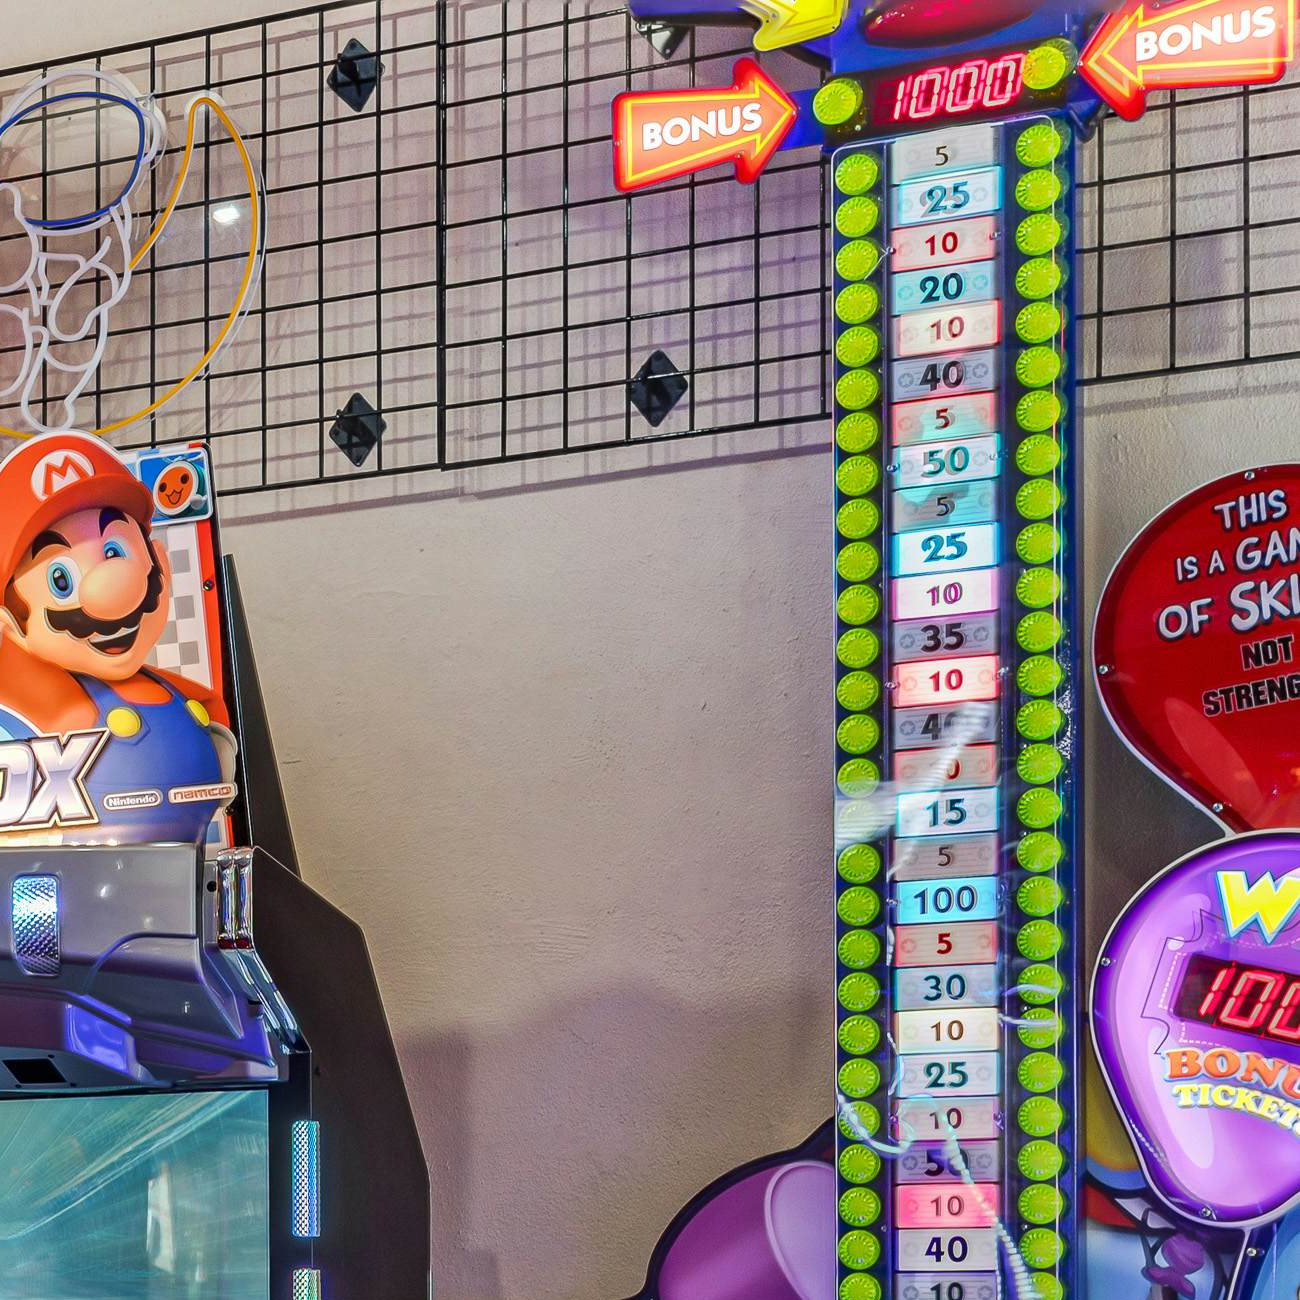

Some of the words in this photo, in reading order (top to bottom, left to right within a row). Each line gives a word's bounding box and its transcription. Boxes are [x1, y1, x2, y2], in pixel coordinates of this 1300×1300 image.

[1136, 7, 1276, 62] BONUS
[894, 53, 1024, 120] 1000
[642, 104, 762, 151] BONUS
[936, 146, 949, 166] 5
[922, 182, 970, 216] 25
[926, 233, 959, 256] 10
[920, 272, 963, 303] 20
[920, 360, 964, 391] 40
[935, 409, 953, 430] 5
[923, 446, 969, 478] 50
[1214, 488, 1288, 529] THIS
[922, 532, 968, 563] 25
[1176, 555, 1199, 582] IS
[1208, 549, 1225, 575] A
[1157, 597, 1213, 640] OF
[921, 623, 965, 653] 35
[1240, 634, 1294, 671] NOT
[929, 669, 963, 692] 10
[108, 795, 156, 808] Nintendo
[173, 785, 232, 801] namco
[926, 799, 967, 826] 15
[914, 886, 976, 915] 100
[937, 933, 953, 955] 5
[923, 973, 967, 1002] 30
[925, 1062, 968, 1088] 25
[930, 1195, 963, 1217] 10
[925, 1236, 968, 1263] 40
